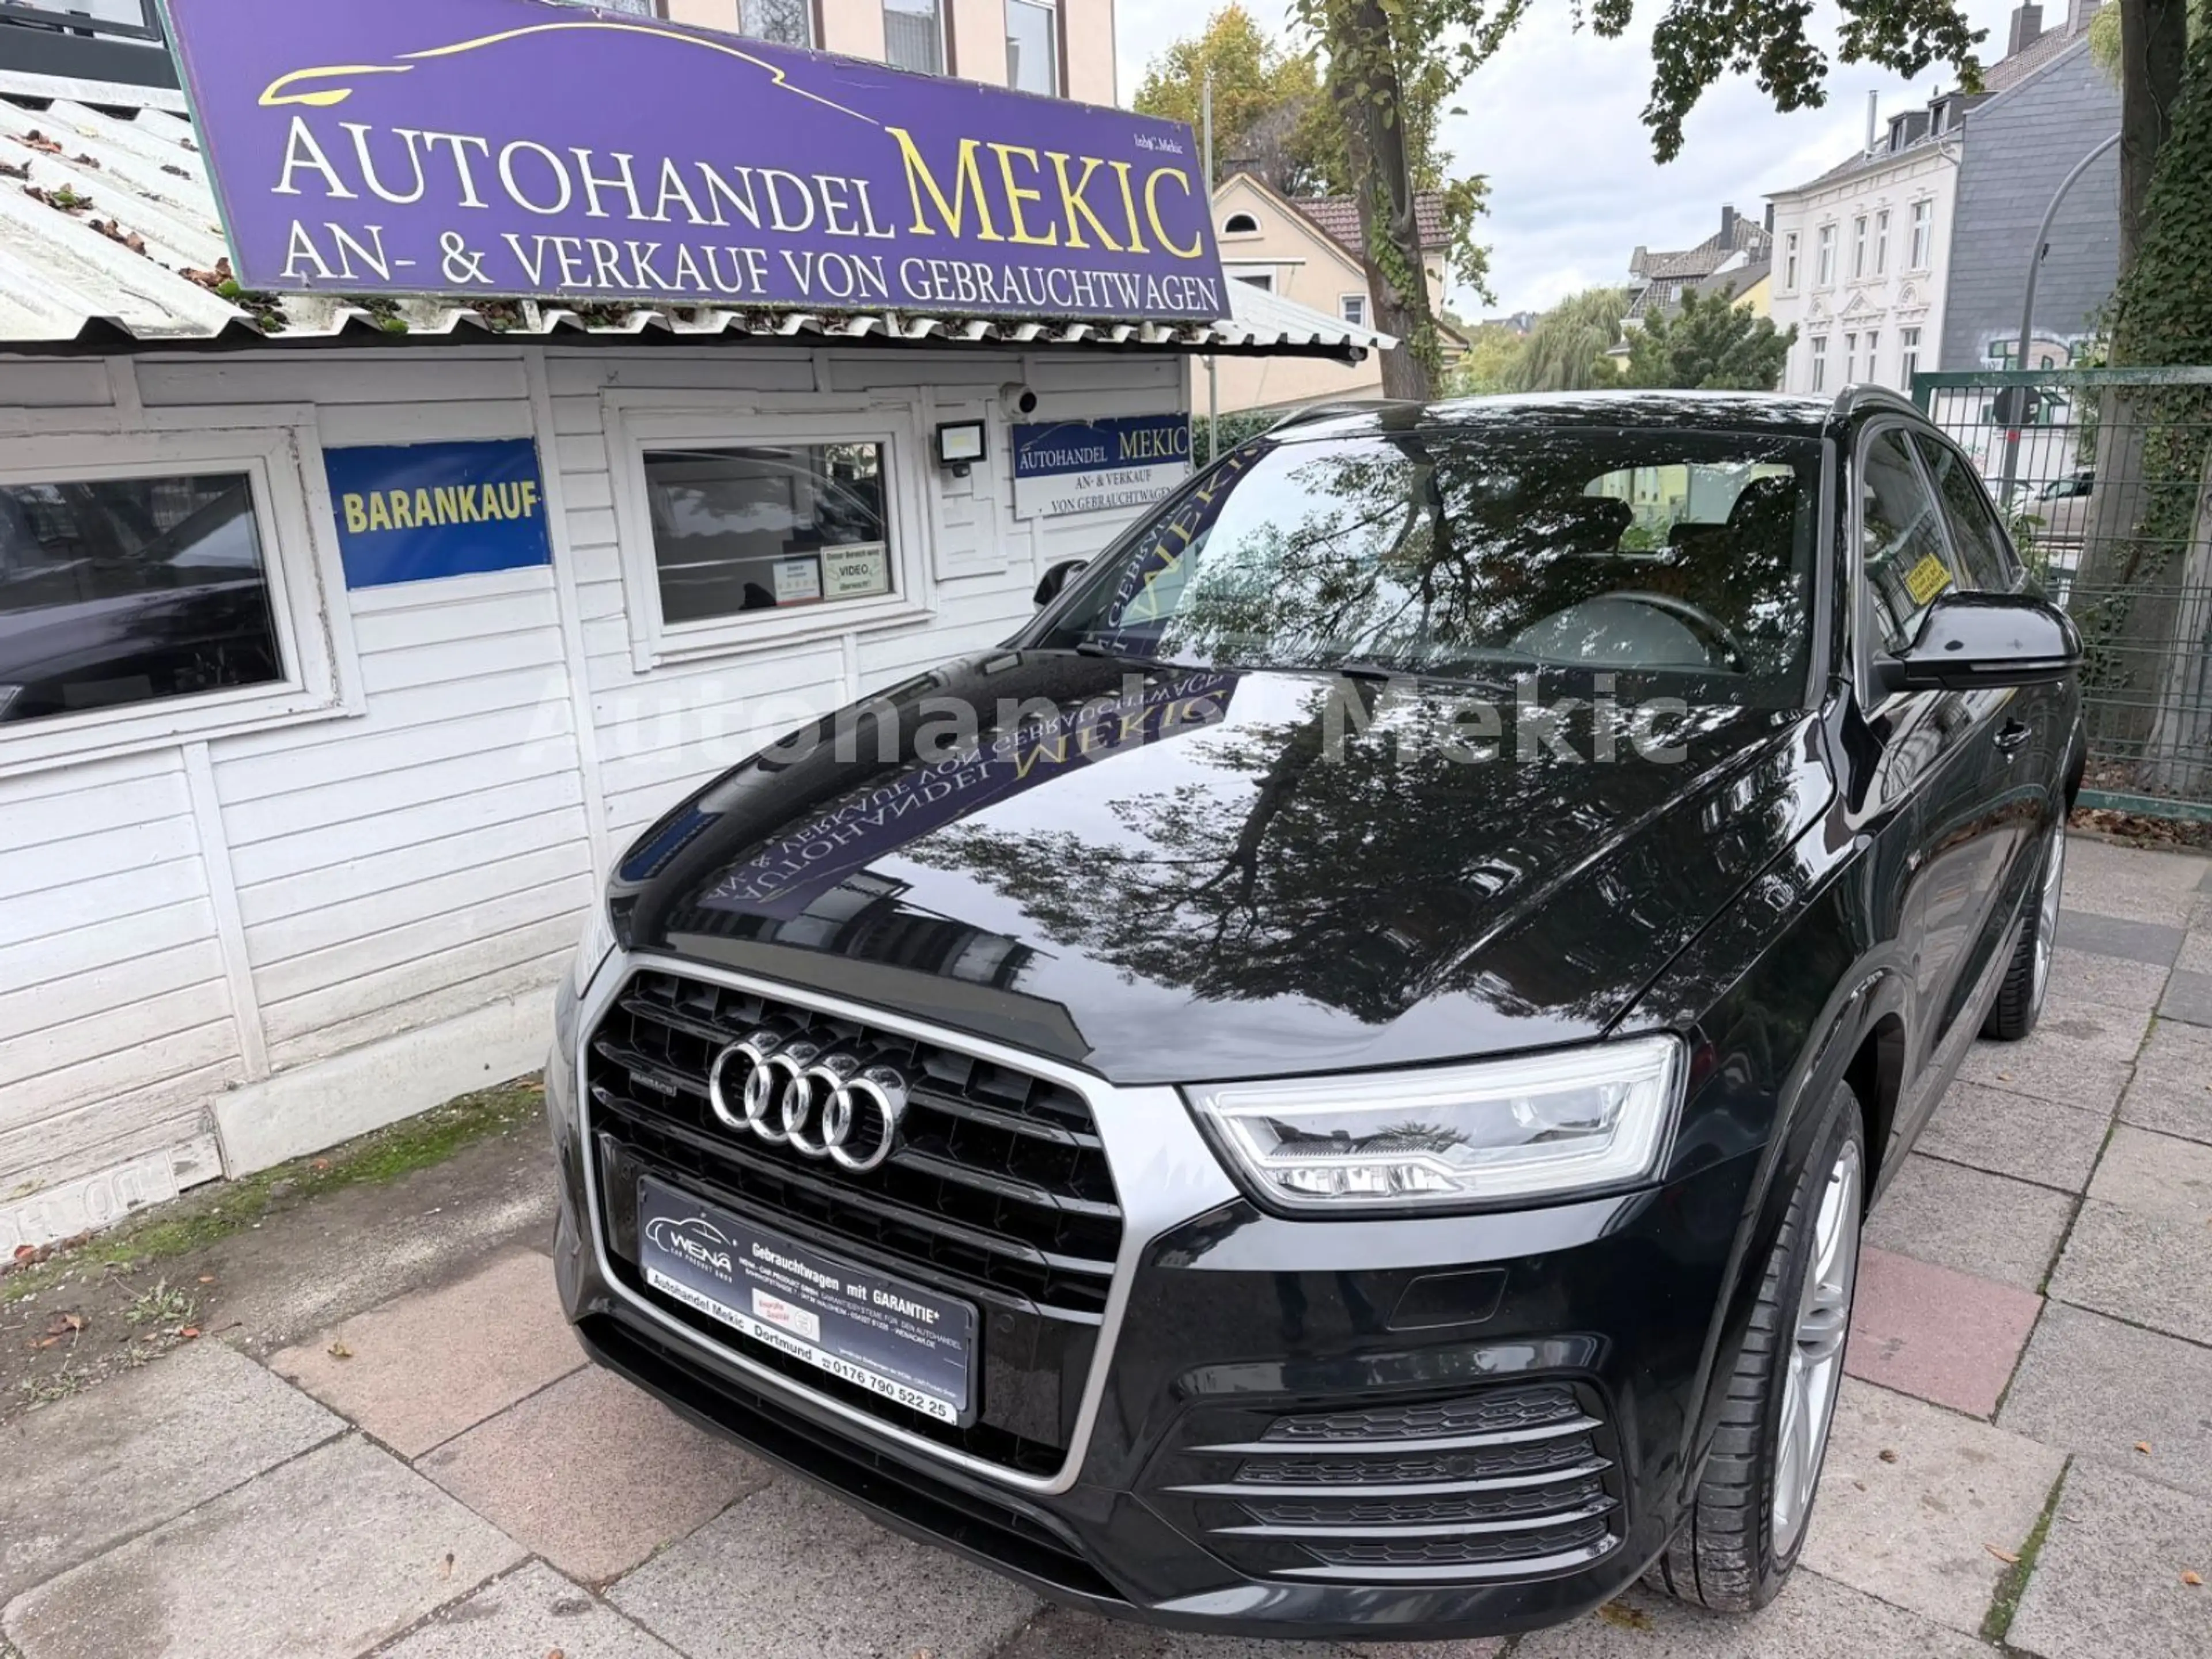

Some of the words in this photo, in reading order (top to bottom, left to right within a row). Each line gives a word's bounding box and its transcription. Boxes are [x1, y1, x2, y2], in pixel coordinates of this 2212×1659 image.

[272, 116, 895, 238] AUTOHANDEL
[885, 127, 1202, 259] MEKIC
[280, 220, 416, 281] AN-
[441, 232, 494, 284] &
[502, 233, 768, 294] VERKAUF
[779, 250, 889, 298] VON
[900, 258, 1219, 312] GEBRAUCHTWAGEN
[1020, 446, 1108, 470] AUTOHANDEL
[1118, 426, 1188, 460] MEKIC
[1096, 473, 1104, 487] &
[1105, 468, 1152, 486] VERKAUF
[343, 480, 537, 533] BARANKAUF
[1051, 499, 1076, 513] VON
[839, 563, 869, 576] VIDEO
[752, 1242, 839, 1291] Gebrauchtwagen
[847, 1283, 868, 1301] mit
[653, 1274, 710, 1311] Autohandel
[713, 1302, 745, 1329] Mekic
[754, 1325, 812, 1361] Dortmund
[833, 1361, 865, 1384] 0176
[869, 1376, 893, 1396] 790
[898, 1388, 925, 1409] 522
[929, 1400, 946, 1417] 25
